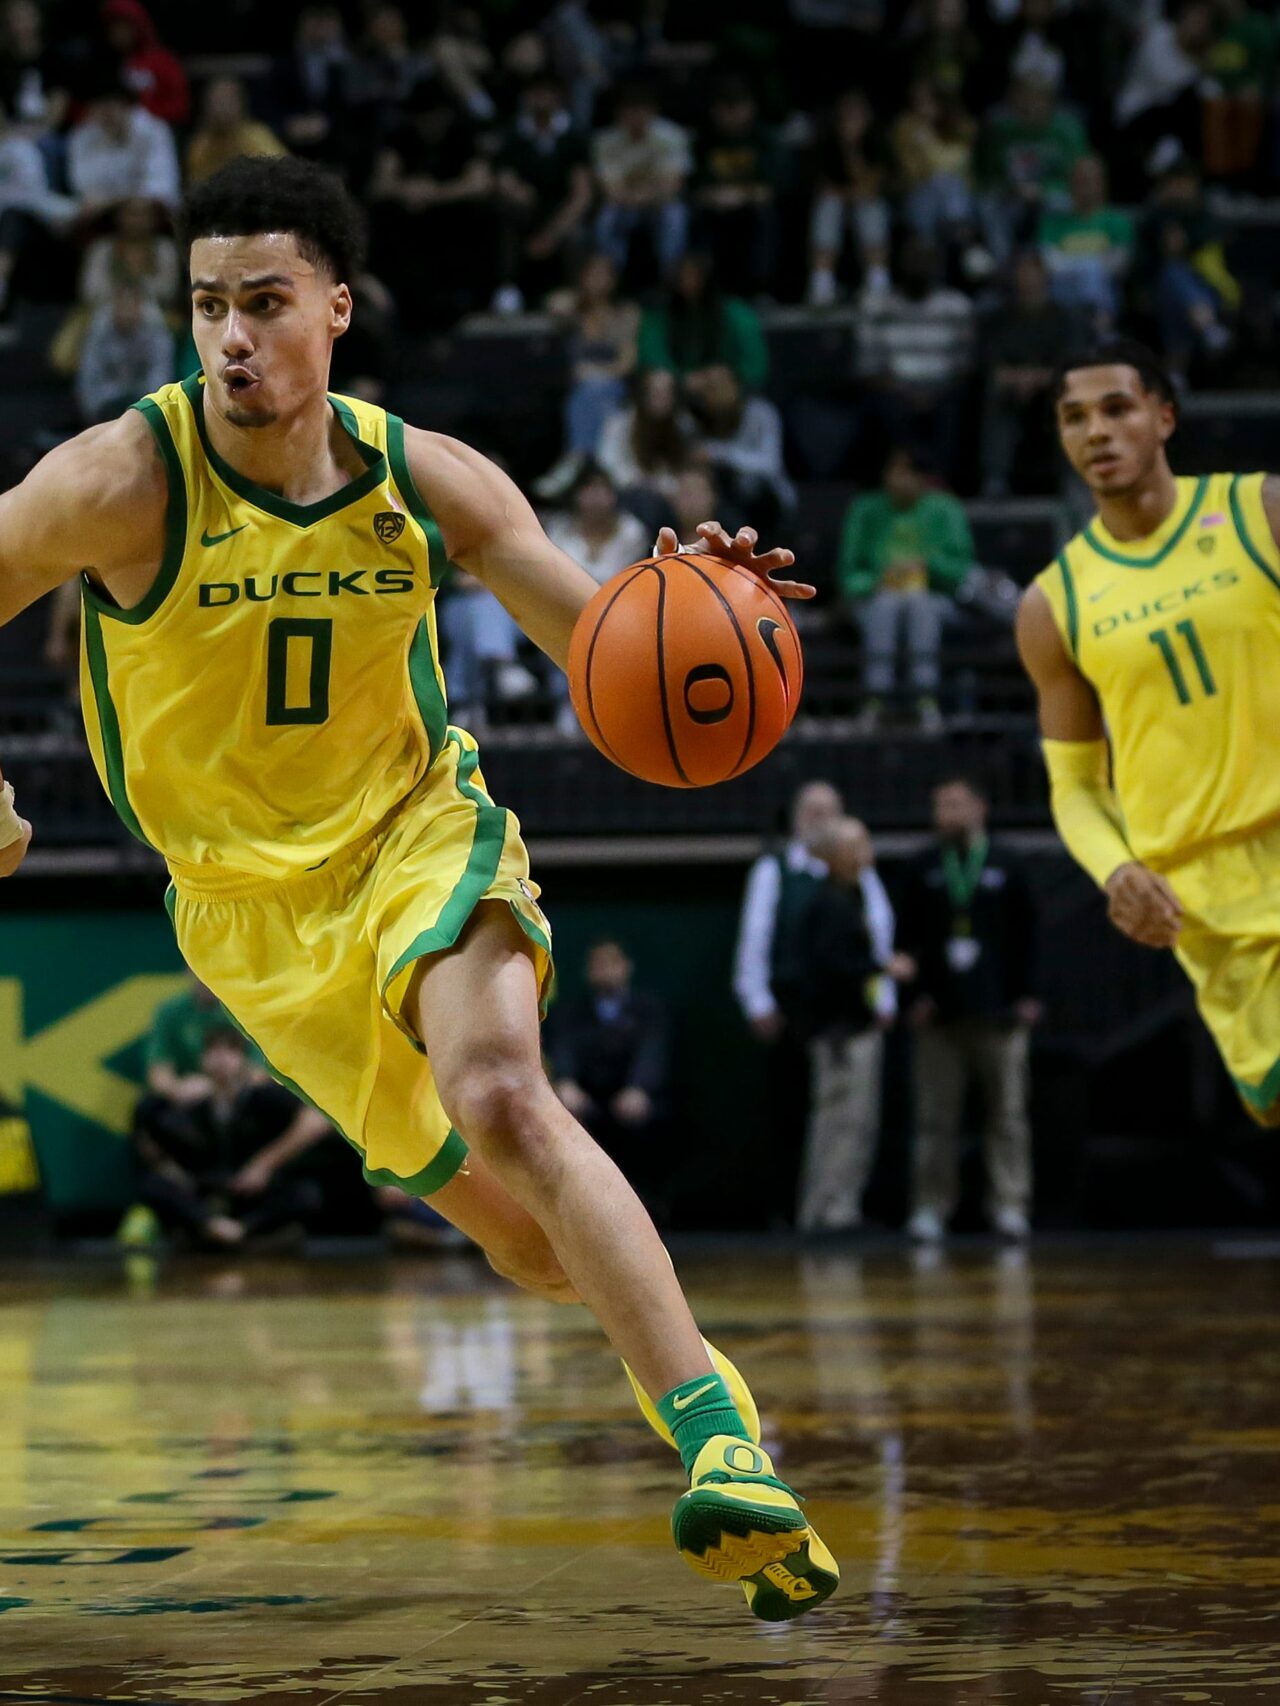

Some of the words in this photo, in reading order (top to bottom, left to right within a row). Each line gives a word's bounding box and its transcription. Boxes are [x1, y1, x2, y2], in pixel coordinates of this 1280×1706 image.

[198, 569, 415, 608] DUCKS
[1093, 569, 1239, 637] DUCKS
[266, 616, 333, 727] 0
[1148, 617, 1218, 706] 11
